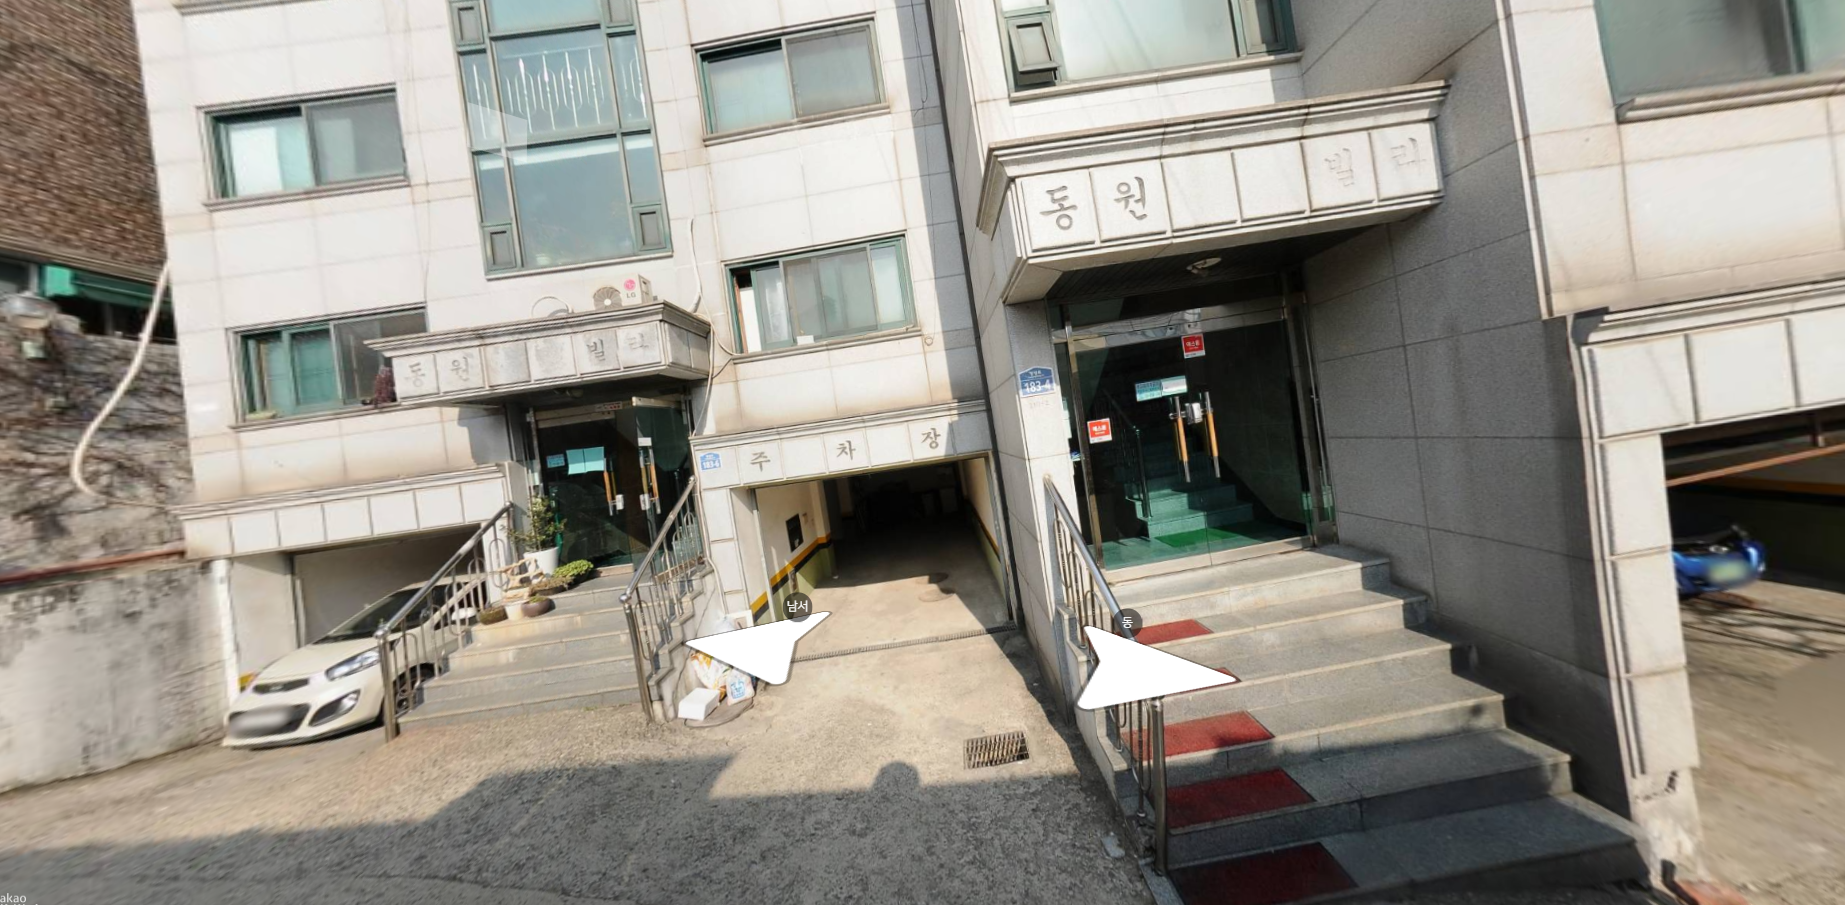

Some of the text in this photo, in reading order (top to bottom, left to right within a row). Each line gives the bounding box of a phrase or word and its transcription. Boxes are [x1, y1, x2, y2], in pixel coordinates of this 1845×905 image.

[1039, 176, 1149, 231] 동원
[626, 291, 637, 299] LG
[1024, 379, 1051, 393] 183-4
